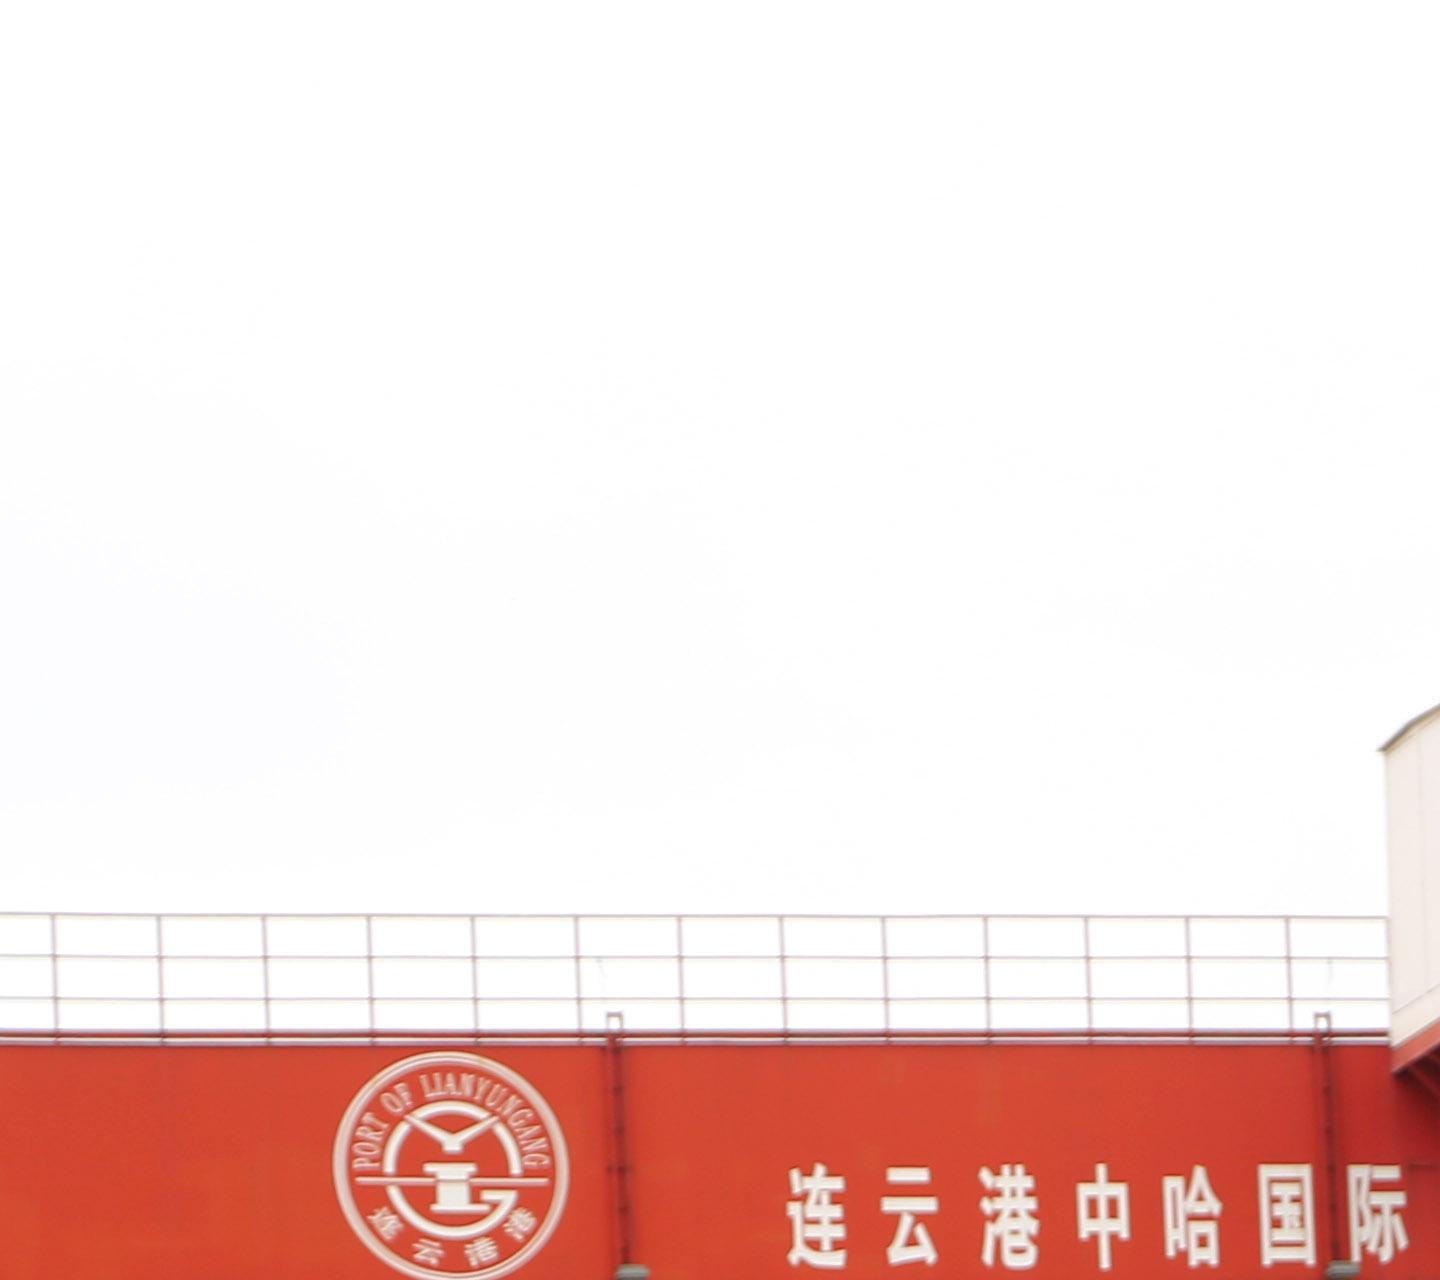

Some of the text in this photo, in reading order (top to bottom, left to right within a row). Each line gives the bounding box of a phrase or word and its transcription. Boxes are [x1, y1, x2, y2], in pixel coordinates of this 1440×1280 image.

[351, 1072, 551, 1171] PORT OF LIANYUNGANG
